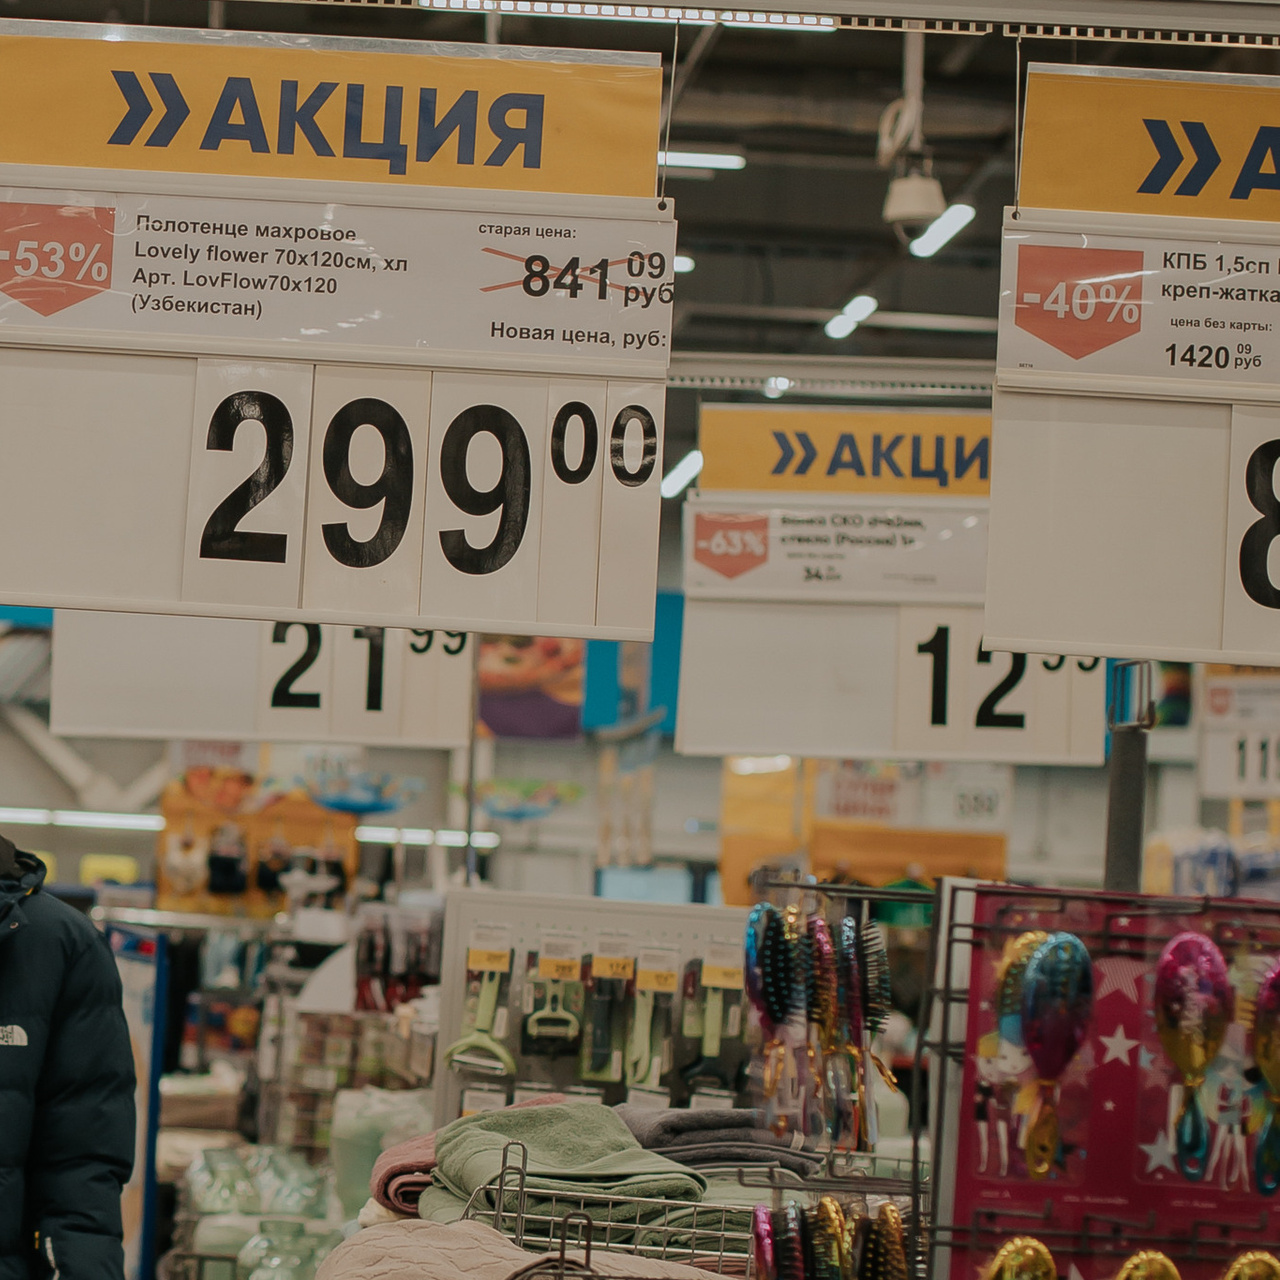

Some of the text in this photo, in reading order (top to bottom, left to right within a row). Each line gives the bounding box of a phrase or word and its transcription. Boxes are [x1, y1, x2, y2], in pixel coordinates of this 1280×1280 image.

[199, 74, 546, 176] АКЦИЯ
[136, 215, 357, 243] Полотенце махровое
[478, 223, 578, 239] старая цена:
[134, 241, 201, 264] Lovely
[206, 244, 269, 264] flower
[382, 258, 408, 272] хл
[1163, 251, 1207, 271] КПБ
[131, 267, 176, 288] Арт.
[522, 250, 666, 300] 841 09
[131, 293, 263, 320] (Узбекистан)
[624, 282, 675, 309] руб
[1023, 281, 1140, 324] -40%
[490, 321, 667, 350] Новая цена, руб:
[1170, 317, 1273, 333] цена без карты:
[1165, 342, 1252, 369] 1420 09
[1234, 355, 1262, 370] руб
[825, 432, 990, 488] АКЦИ
[199, 390, 658, 576] 299 00
[696, 530, 767, 557] -63%
[271, 621, 386, 711] 21
[917, 625, 1027, 729] 12
